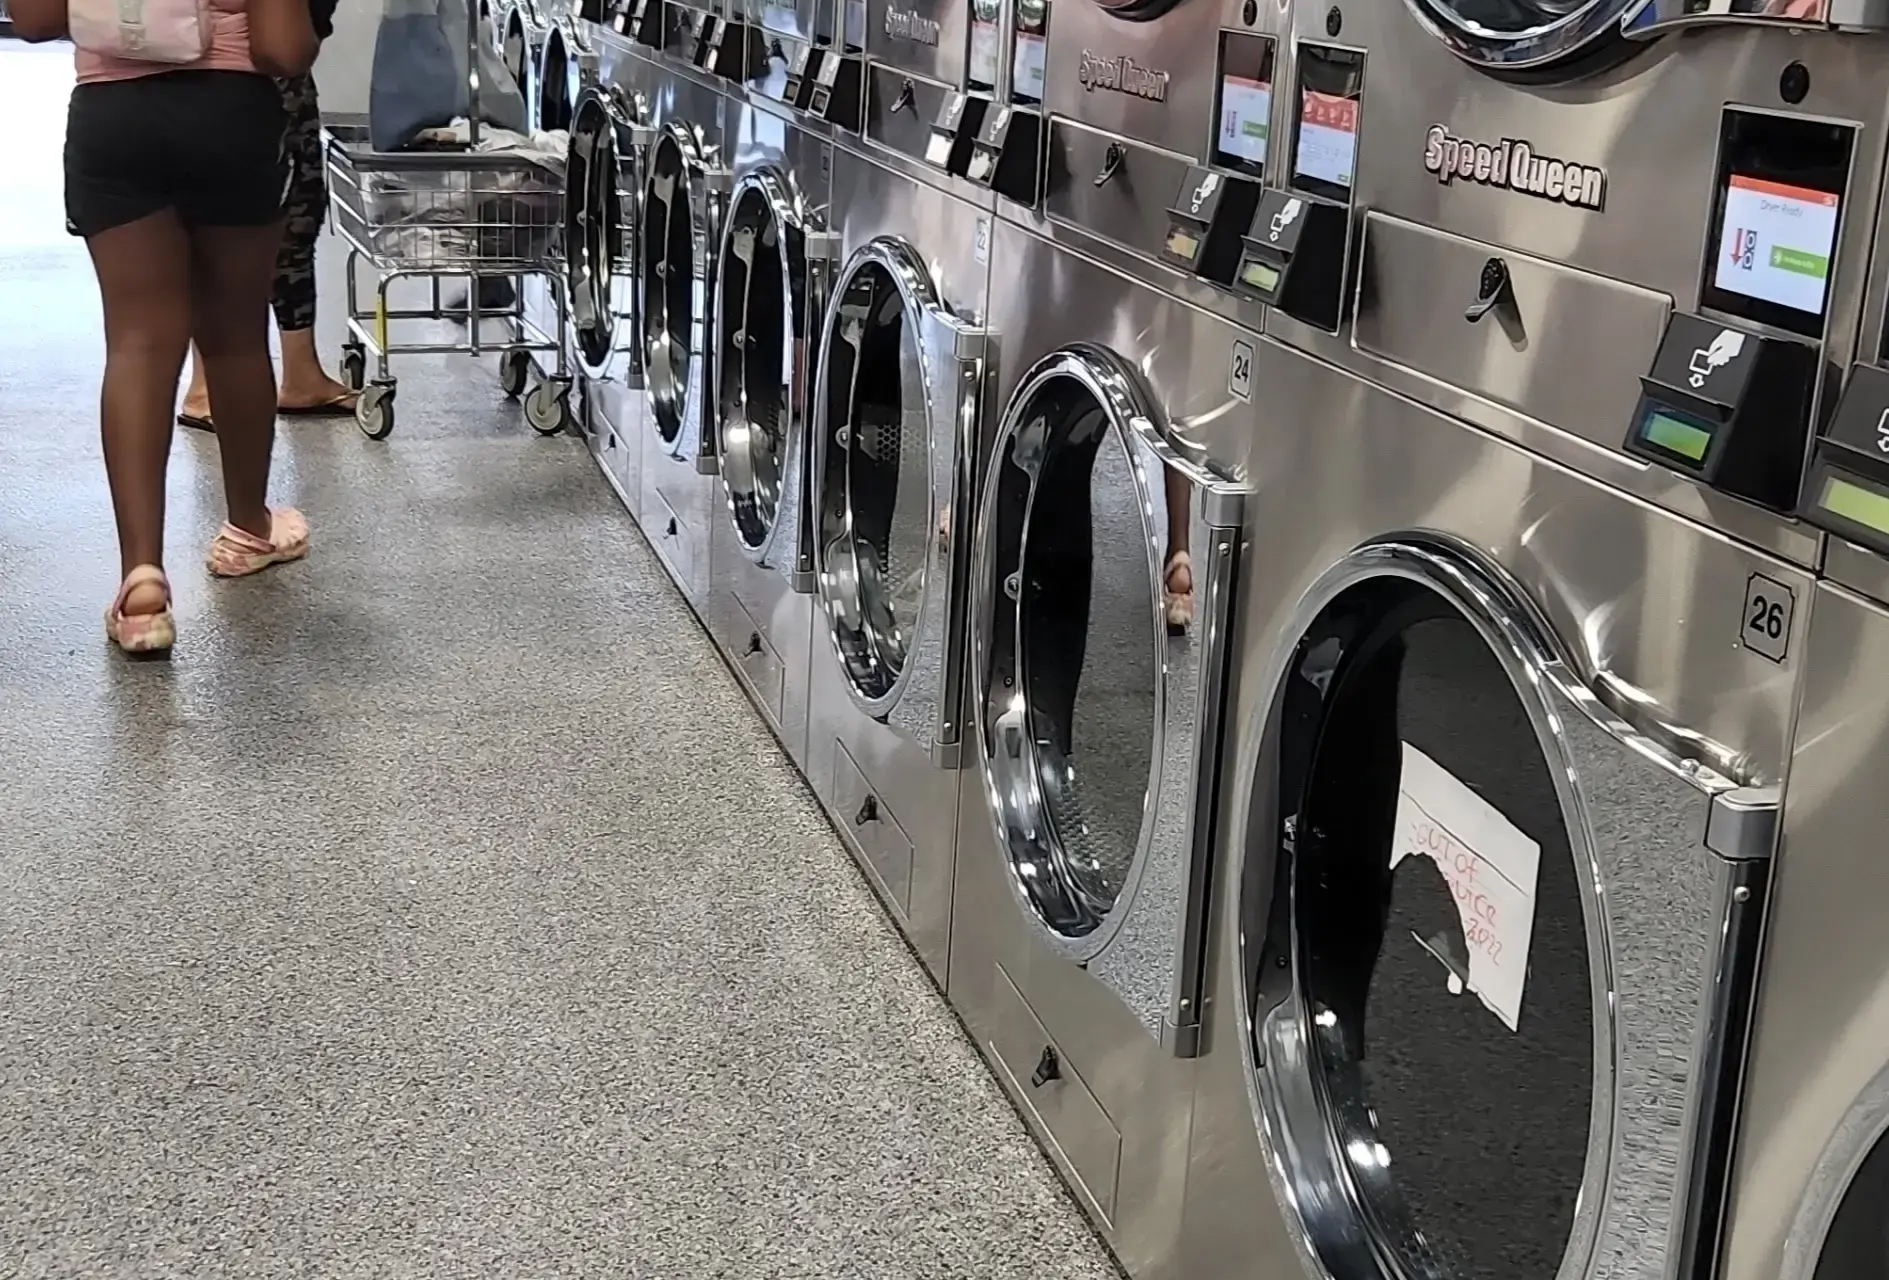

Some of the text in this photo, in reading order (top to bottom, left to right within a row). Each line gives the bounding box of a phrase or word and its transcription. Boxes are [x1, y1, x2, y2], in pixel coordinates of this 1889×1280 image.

[1080, 48, 1168, 103] Speed Queen
[1424, 124, 1605, 210] Speed Queen
[977, 230, 986, 250] 22
[1234, 355, 1249, 383] 24
[1749, 595, 1784, 639] 26
